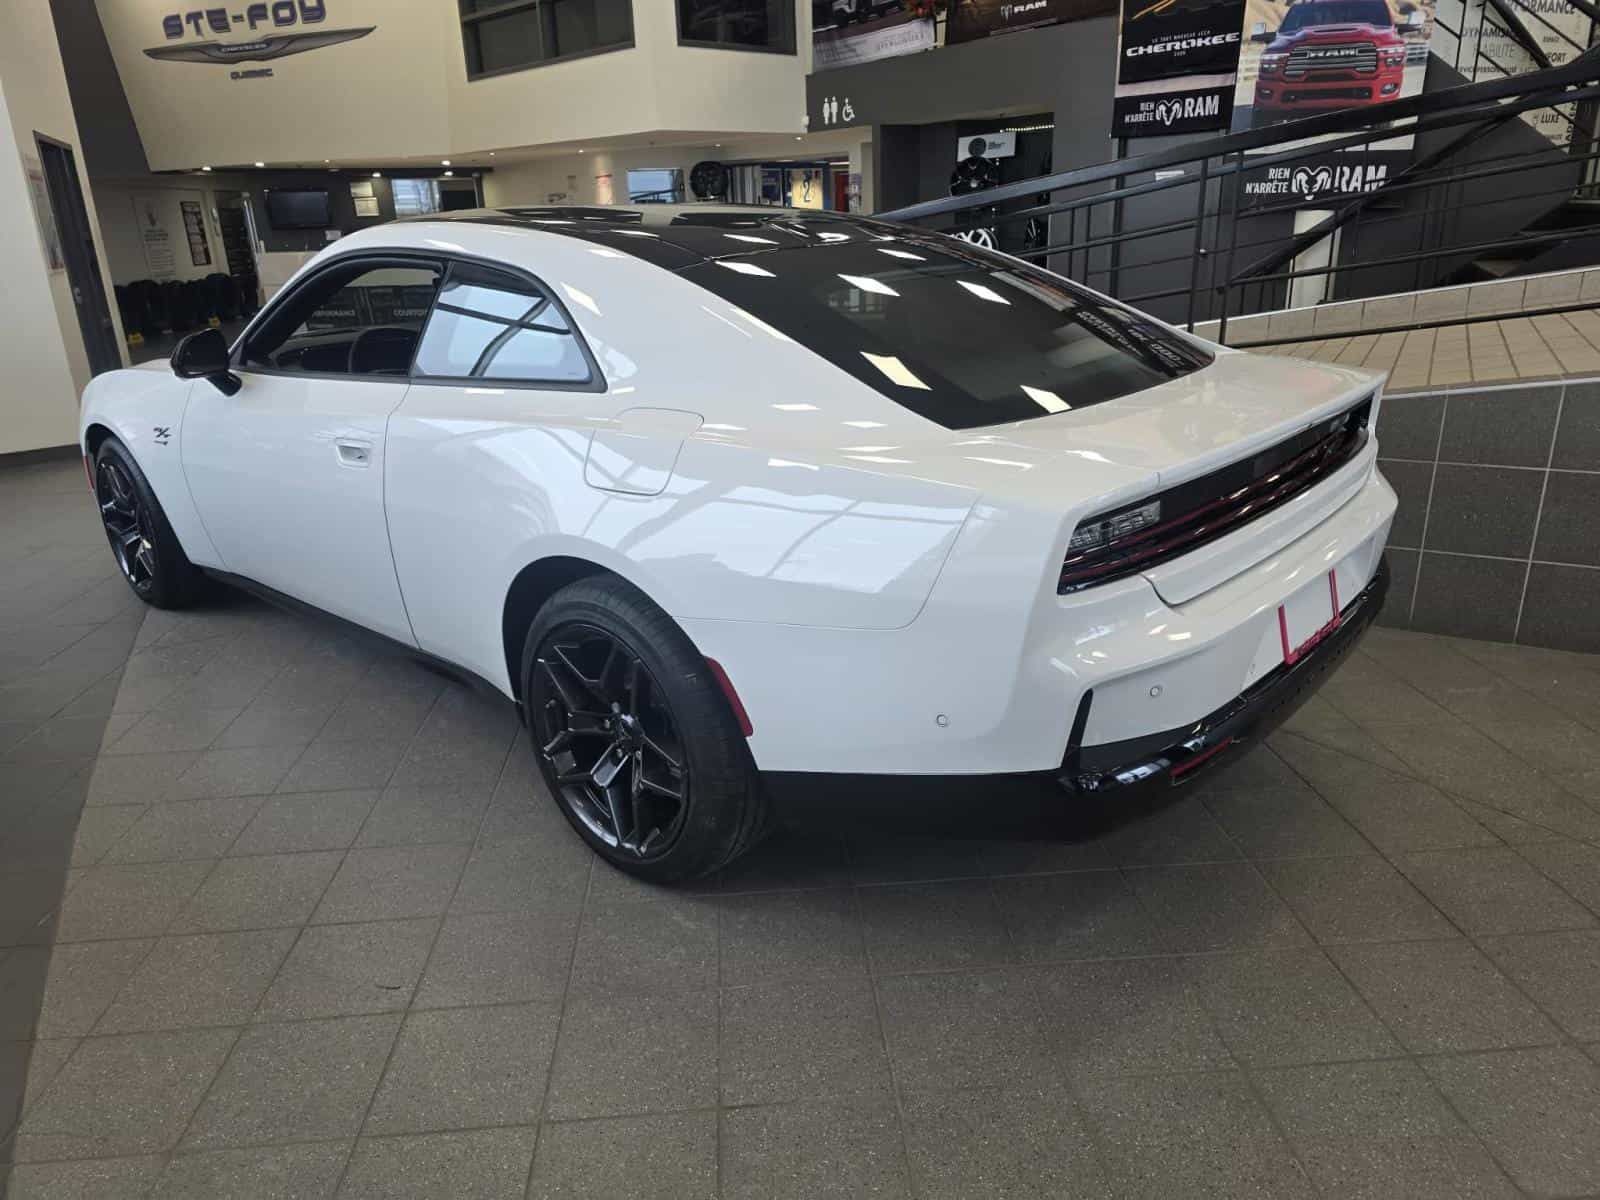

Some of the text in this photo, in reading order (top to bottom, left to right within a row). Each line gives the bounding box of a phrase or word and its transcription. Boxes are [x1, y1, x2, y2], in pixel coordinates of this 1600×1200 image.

[1013, 0, 1048, 13] RAM
[162, 0, 328, 40] STE-FOY
[1126, 32, 1240, 57] CHEROKEE
[1309, 48, 1357, 58] RAM
[1140, 101, 1155, 112] RIEN
[1184, 95, 1219, 118] RAM
[1245, 165, 1388, 194] N'ARRÊTE RAM
[1268, 167, 1291, 180] RIEN
